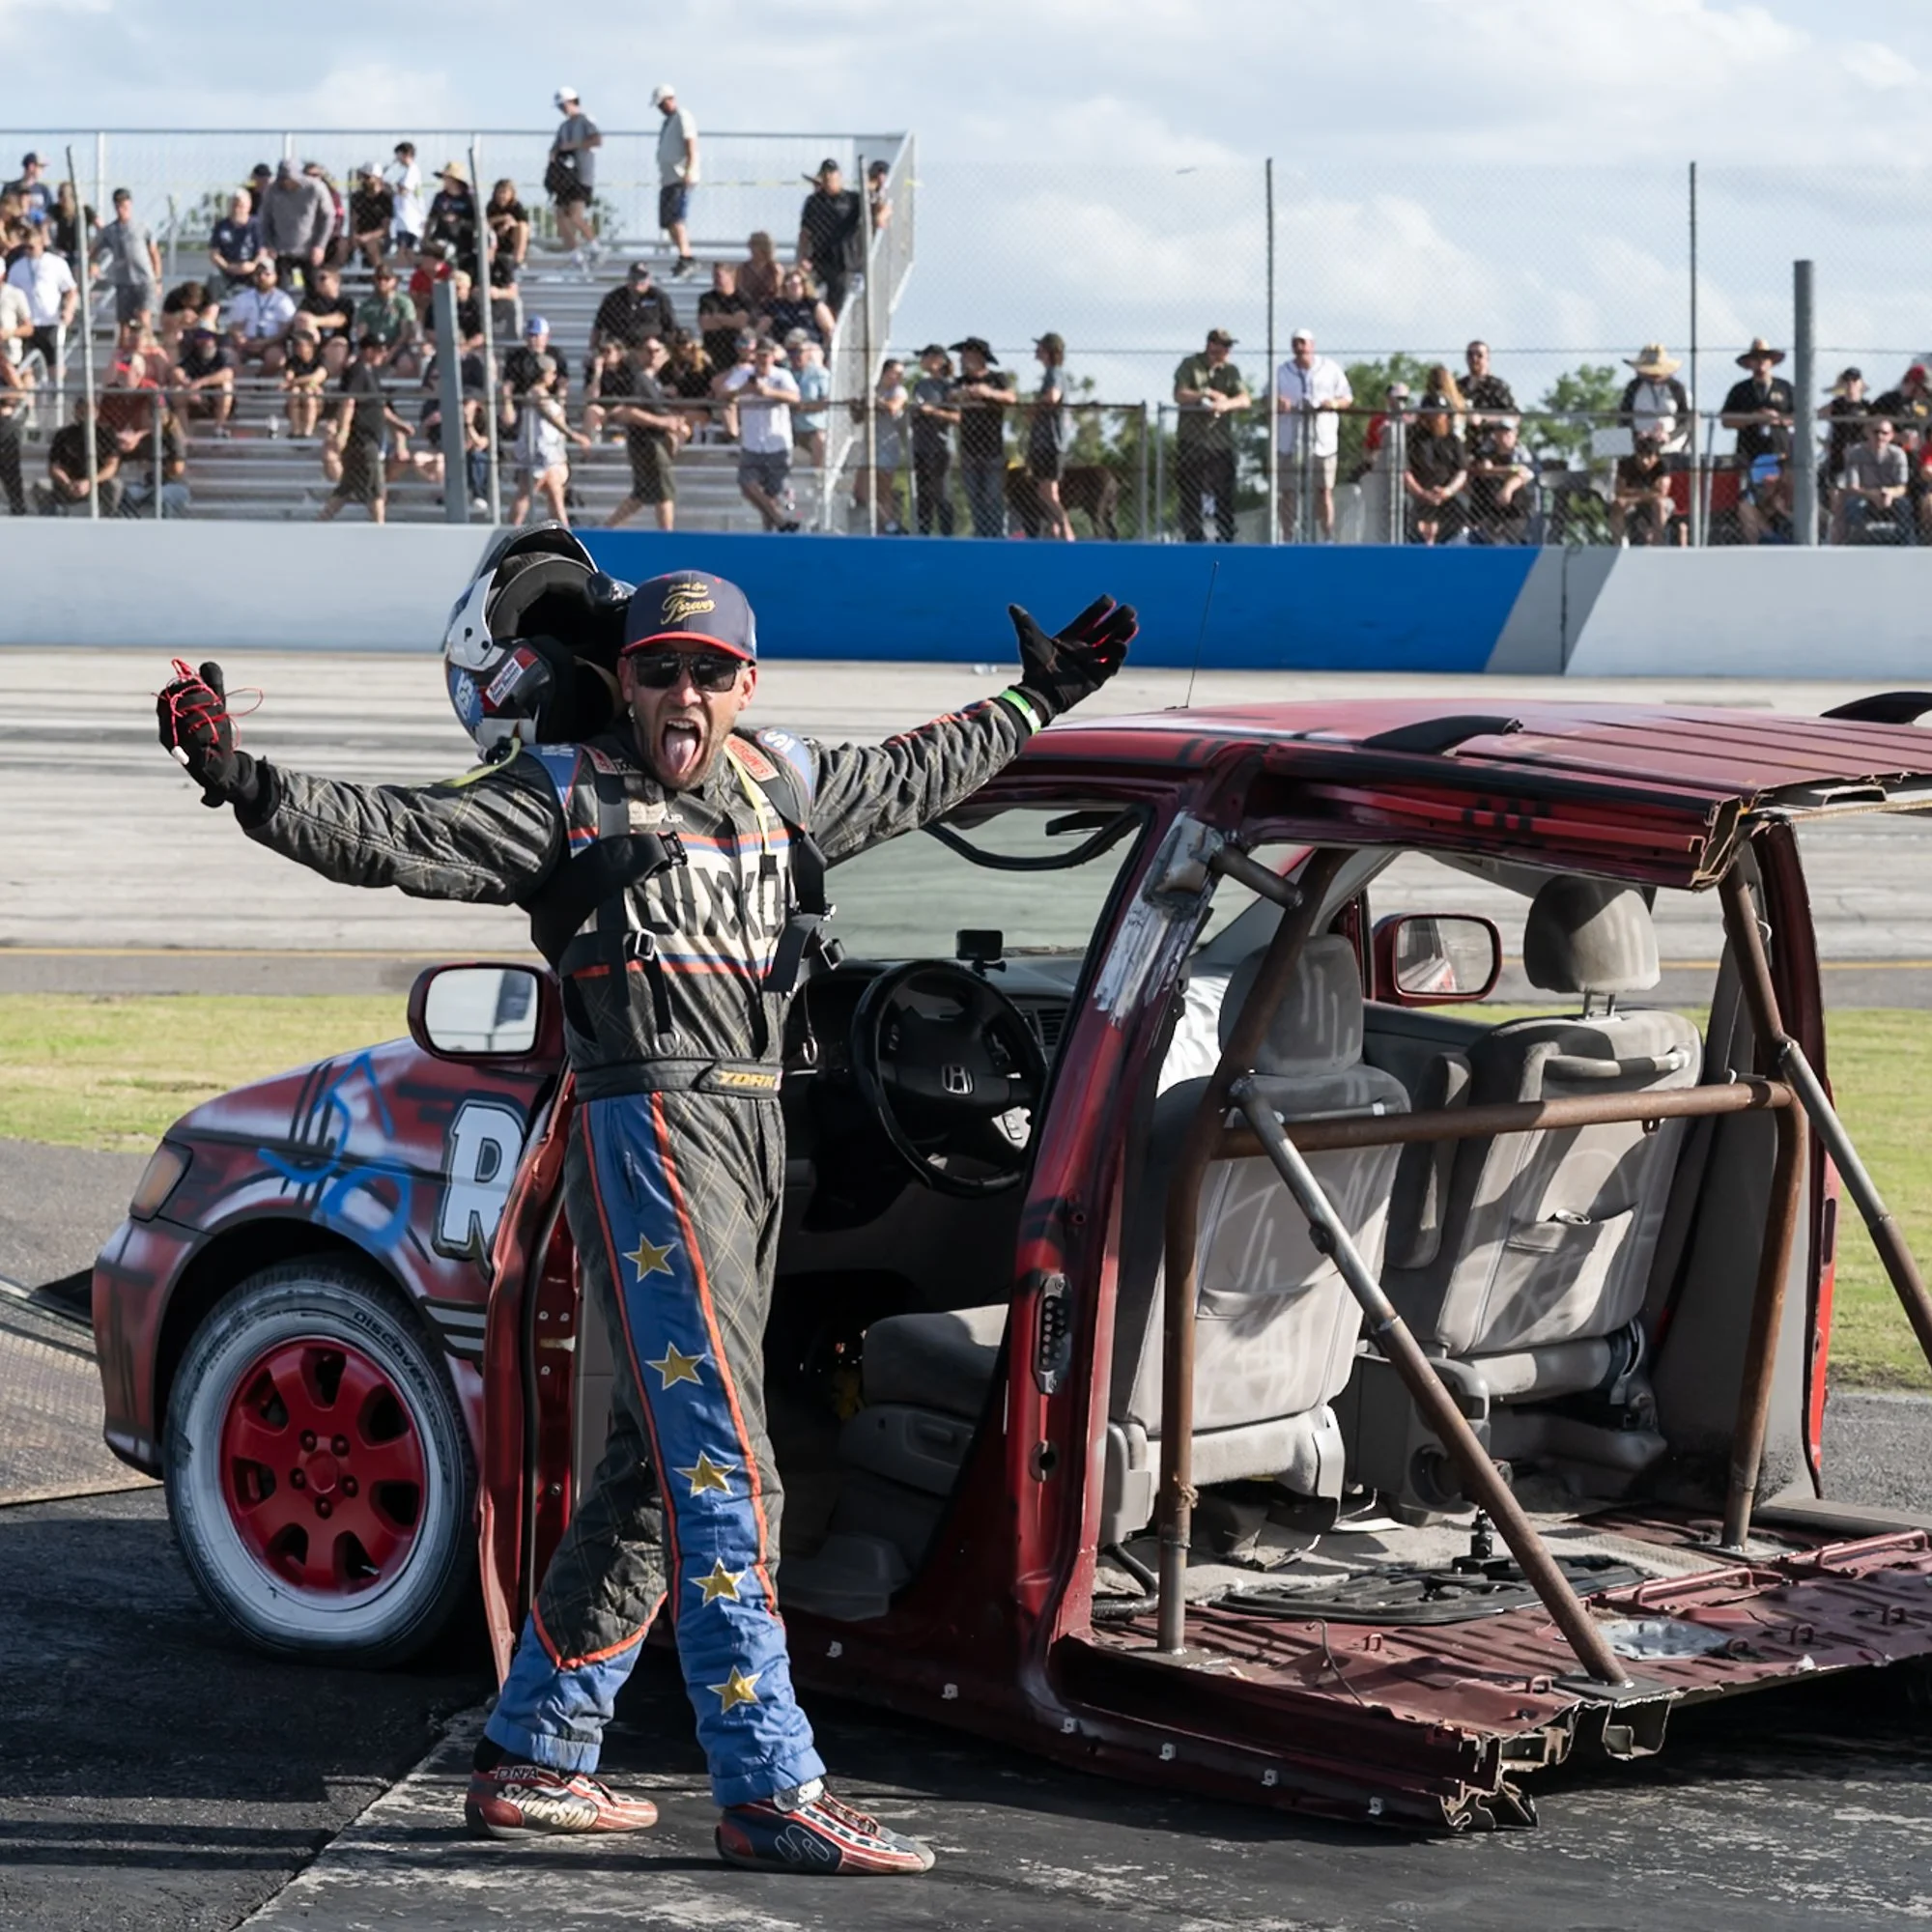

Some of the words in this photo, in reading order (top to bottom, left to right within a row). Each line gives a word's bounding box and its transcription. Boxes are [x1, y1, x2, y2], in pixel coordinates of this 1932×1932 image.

[718, 1070, 776, 1088] YORK
[496, 1766, 538, 1779] DNA
[496, 1783, 598, 1830] SIMPSON
